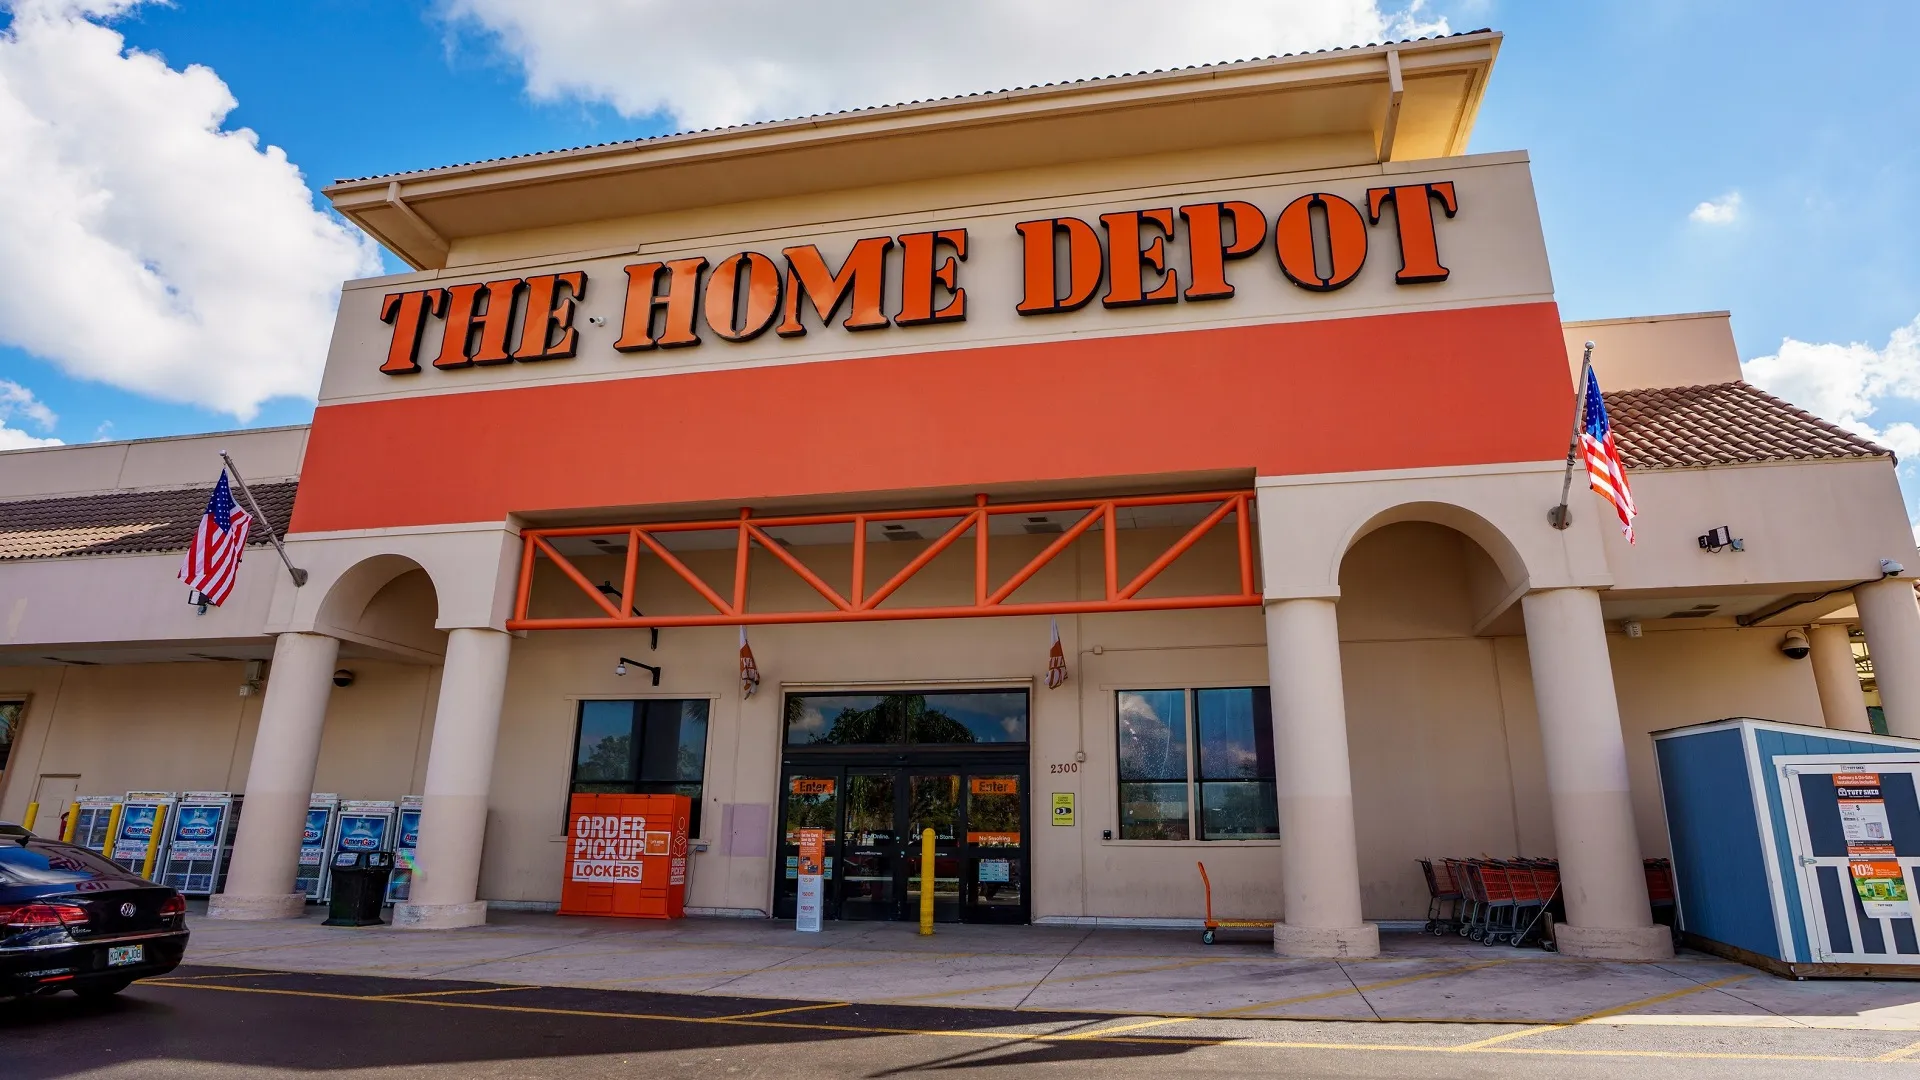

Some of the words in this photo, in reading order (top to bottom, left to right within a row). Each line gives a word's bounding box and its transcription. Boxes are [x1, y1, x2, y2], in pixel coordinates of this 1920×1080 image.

[379, 270, 588, 375] THE
[613, 228, 969, 353] HOME
[1015, 181, 1458, 316] DEPOT
[1050, 762, 1078, 774] 2300
[800, 782, 828, 793] Enter
[979, 781, 1009, 792] Enter
[126, 826, 153, 834] AmeriGa
[181, 827, 212, 835] AmeriGas
[576, 815, 646, 839] ORDER
[343, 837, 377, 847] AmeriGas
[574, 838, 645, 860] PICKUP
[575, 864, 640, 878] LOCKERS
